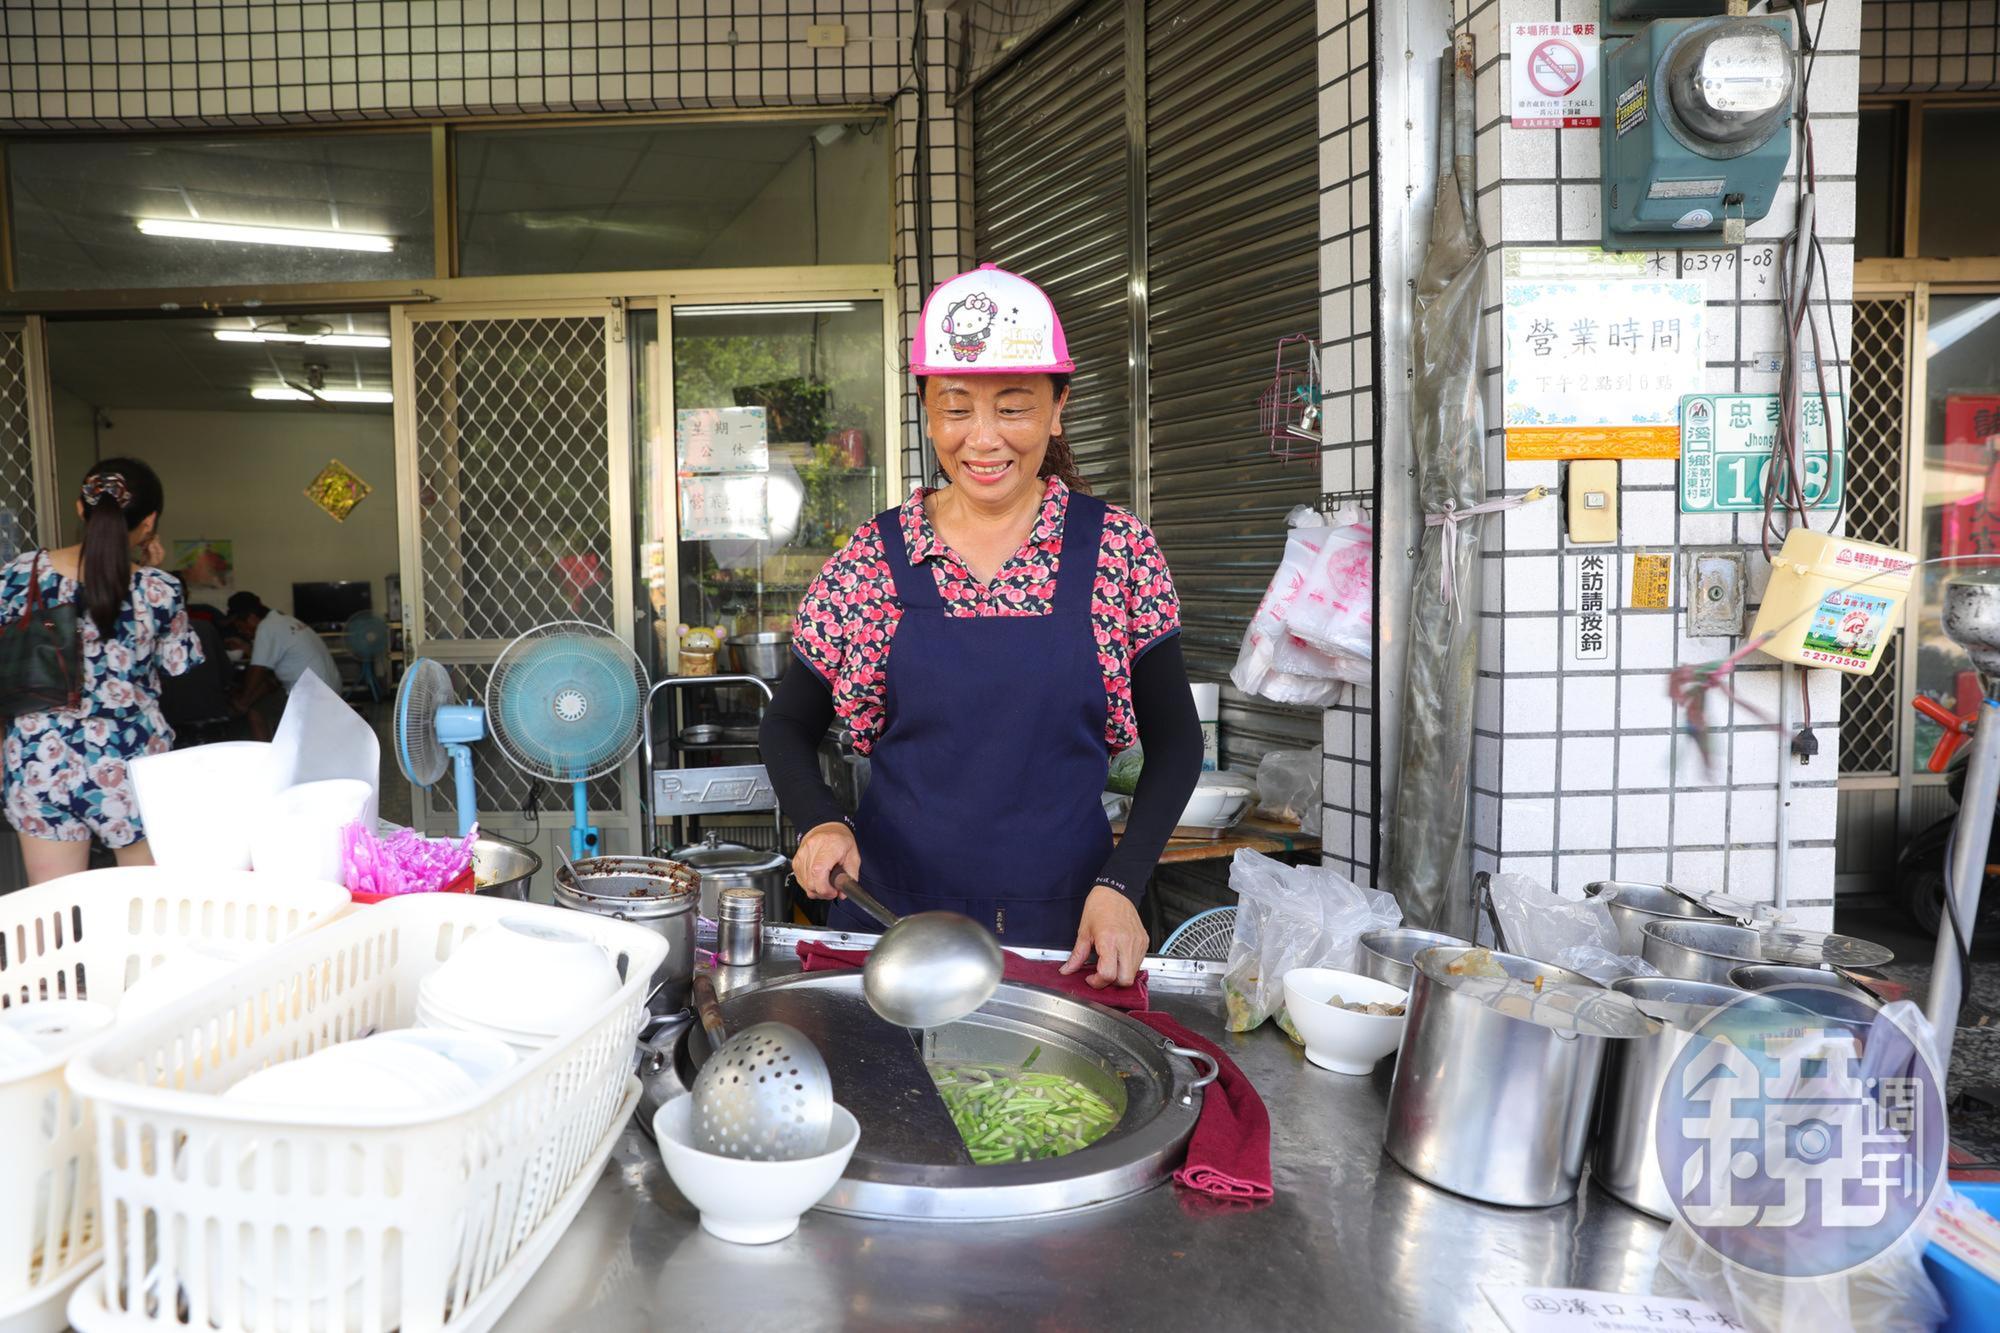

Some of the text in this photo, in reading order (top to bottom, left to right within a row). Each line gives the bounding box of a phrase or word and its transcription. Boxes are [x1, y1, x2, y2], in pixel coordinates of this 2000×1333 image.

[1516, 24, 1595, 36] 本場所禁止吸菸
[1683, 248, 1773, 272] 0399-08
[1525, 316, 1681, 357] 營業時間
[692, 421, 753, 437] 星期一
[702, 443, 746, 458] 公休
[1687, 426, 1711, 466] 溪口鄉
[1581, 555, 1604, 652] 來訪請按鈴
[1812, 652, 1867, 669] 2373503
